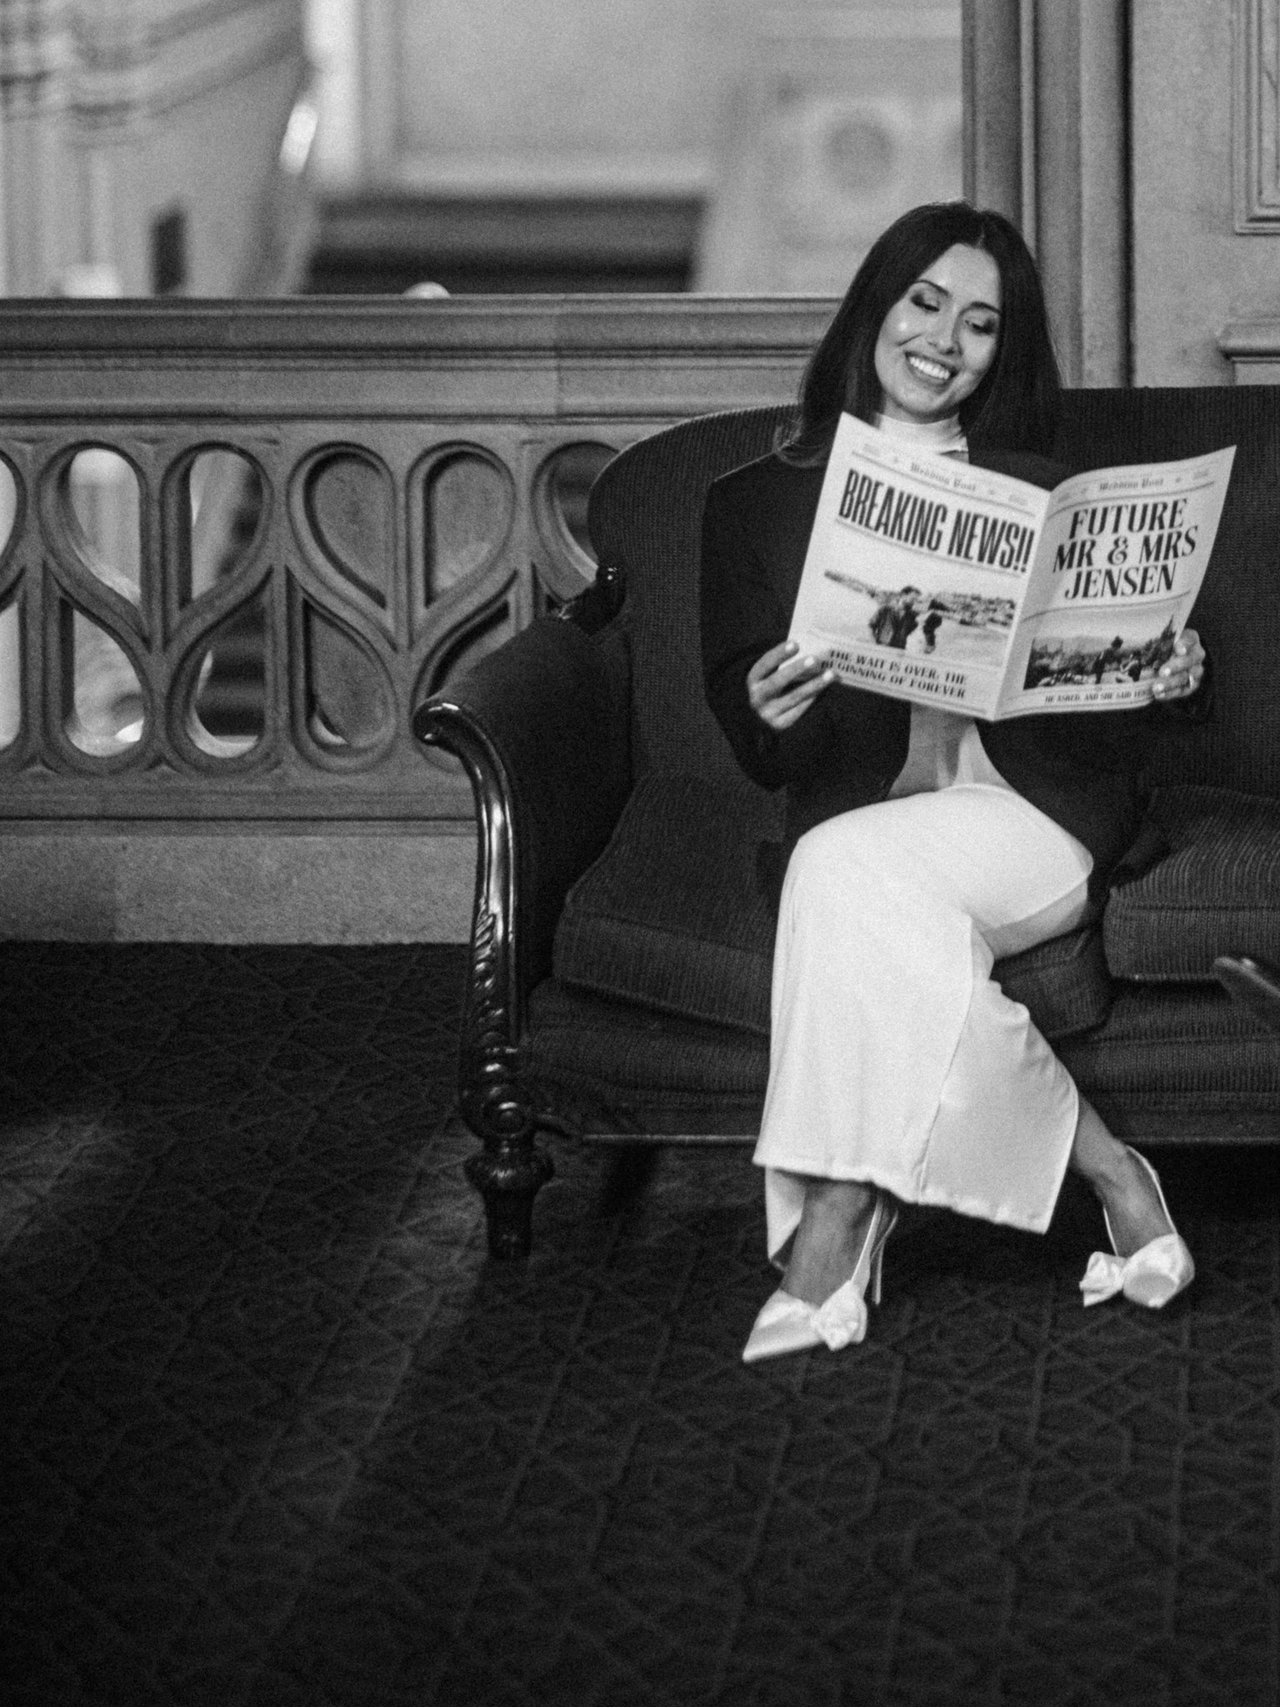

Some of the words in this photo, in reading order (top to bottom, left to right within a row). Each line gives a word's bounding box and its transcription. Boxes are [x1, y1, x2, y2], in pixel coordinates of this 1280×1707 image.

[838, 468, 947, 552] BREAKING
[947, 509, 1036, 573] NEWS!!
[1068, 498, 1188, 540] FUTURE
[1052, 539, 1096, 573] MR
[1107, 537, 1128, 566] &
[1138, 526, 1199, 563] MRS
[1064, 562, 1178, 600] JENSEN
[820, 660, 886, 682] BEGINNING
[890, 674, 904, 685] OF
[909, 679, 966, 698] FOREVER
[830, 650, 849, 661] THE
[856, 655, 884, 669] WAIT
[889, 661, 900, 672] IS
[945, 672, 965, 684] THE
[1084, 693, 1098, 701] AND
